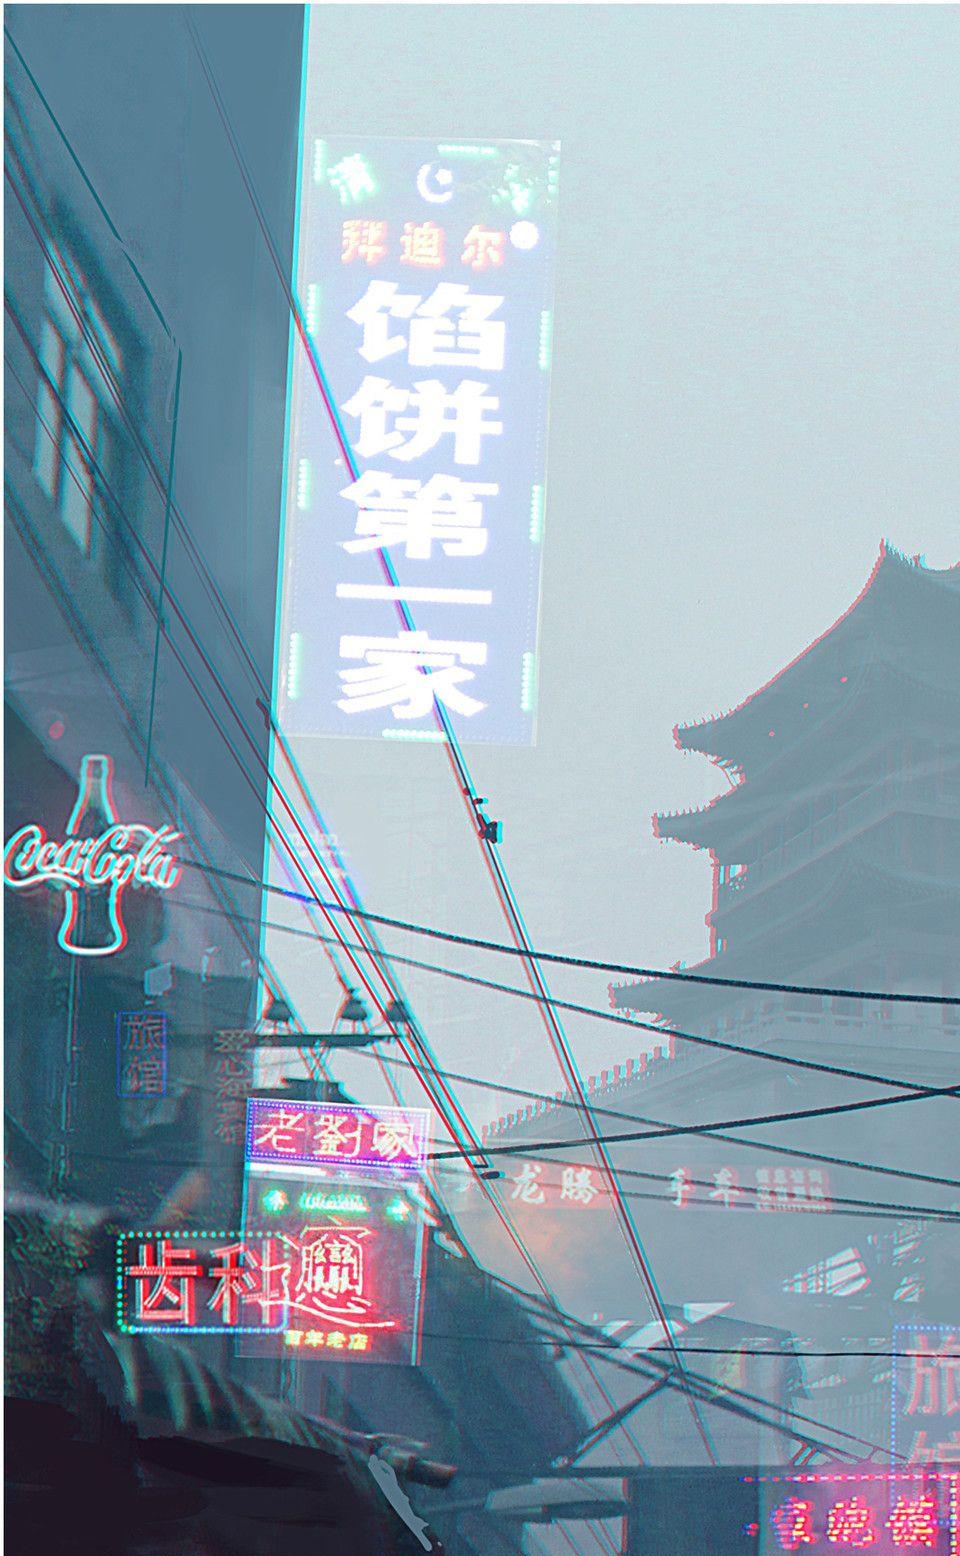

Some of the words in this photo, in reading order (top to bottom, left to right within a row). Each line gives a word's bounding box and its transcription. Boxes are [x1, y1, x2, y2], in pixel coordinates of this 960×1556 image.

[336, 281, 506, 721] 馅饼第一家
[125, 1239, 282, 1326] 齿科
